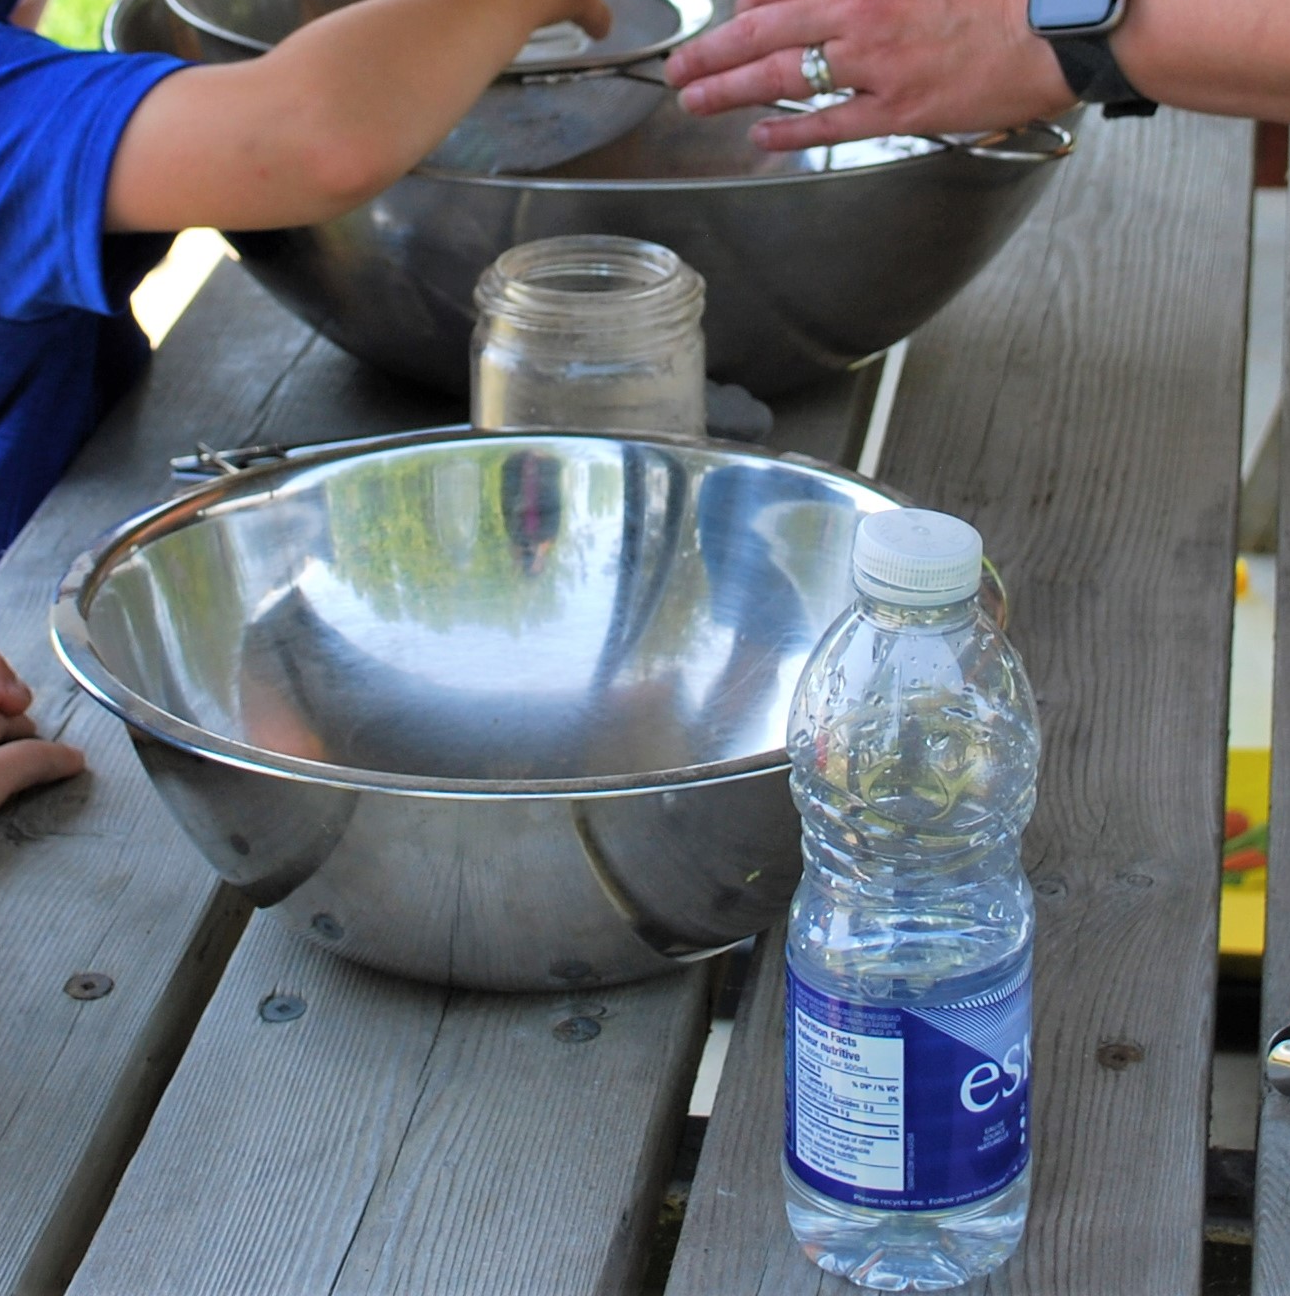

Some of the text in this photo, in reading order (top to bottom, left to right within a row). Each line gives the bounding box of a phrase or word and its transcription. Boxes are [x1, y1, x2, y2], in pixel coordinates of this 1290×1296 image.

[798, 1012, 857, 1047] Nutrition Facts
[820, 1040, 861, 1061] nutritive
